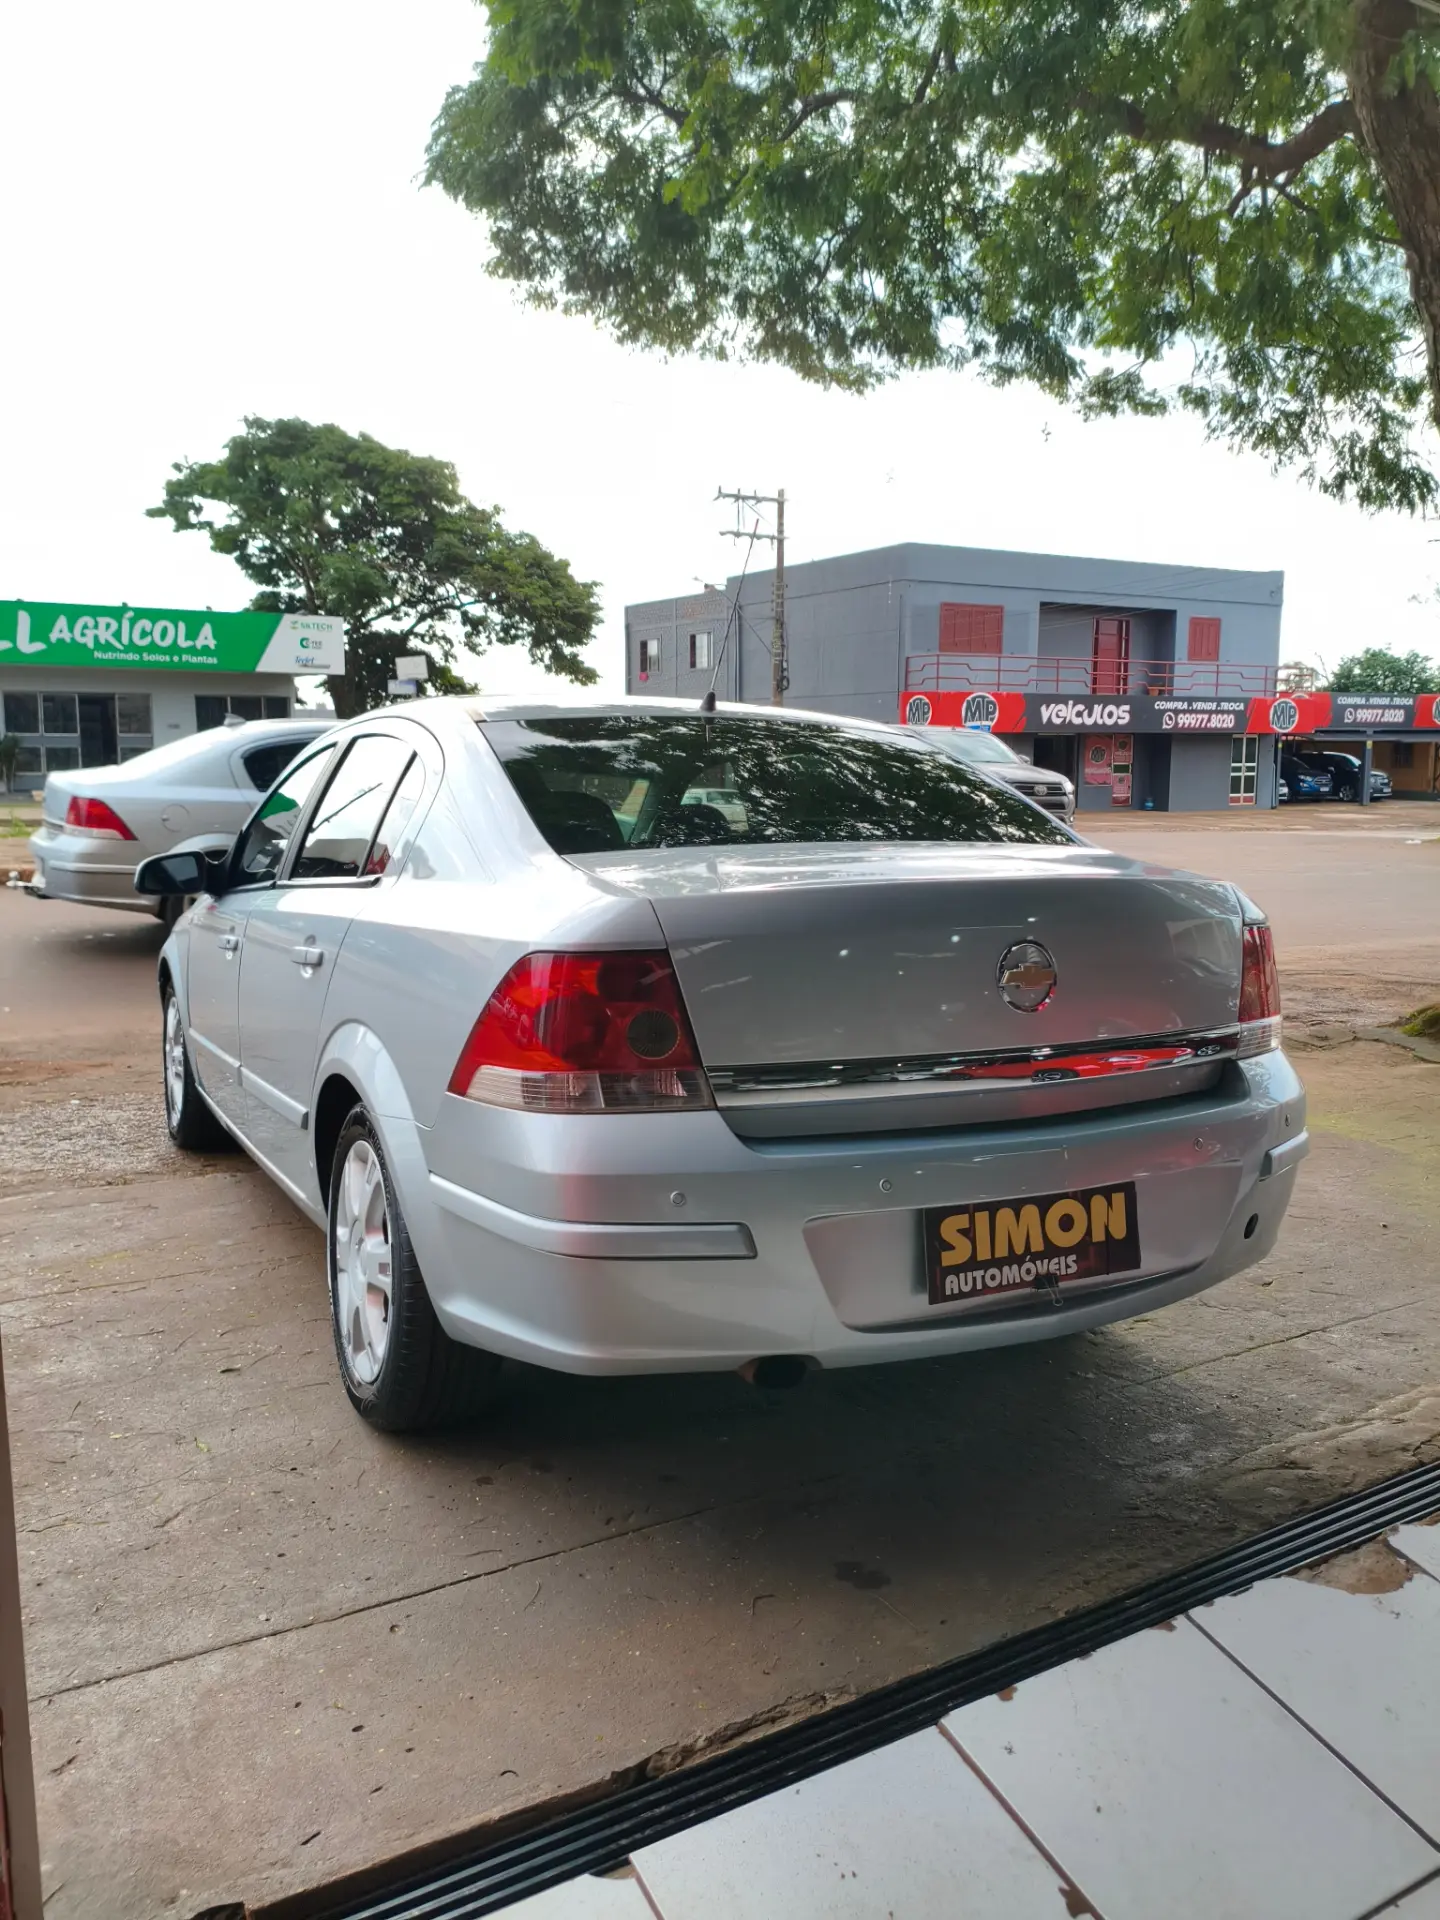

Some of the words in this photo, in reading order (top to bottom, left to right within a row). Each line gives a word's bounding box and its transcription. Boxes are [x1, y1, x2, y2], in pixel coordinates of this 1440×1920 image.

[49, 610, 217, 650] AGRÍCOLA
[93, 651, 139, 661] Nutrindo
[142, 652, 170, 662] Solos
[182, 654, 218, 664] Plantas
[907, 700, 931, 724] MP
[964, 698, 998, 722] MP
[1154, 701, 1188, 709] COMPRA
[1337, 696, 1366, 705] COMPRA
[1177, 713, 1235, 728] 99977.8020
[1271, 703, 1297, 728] MP
[940, 1192, 1127, 1267] SIMON
[945, 1254, 1078, 1296] AUTOMÓVEIS
